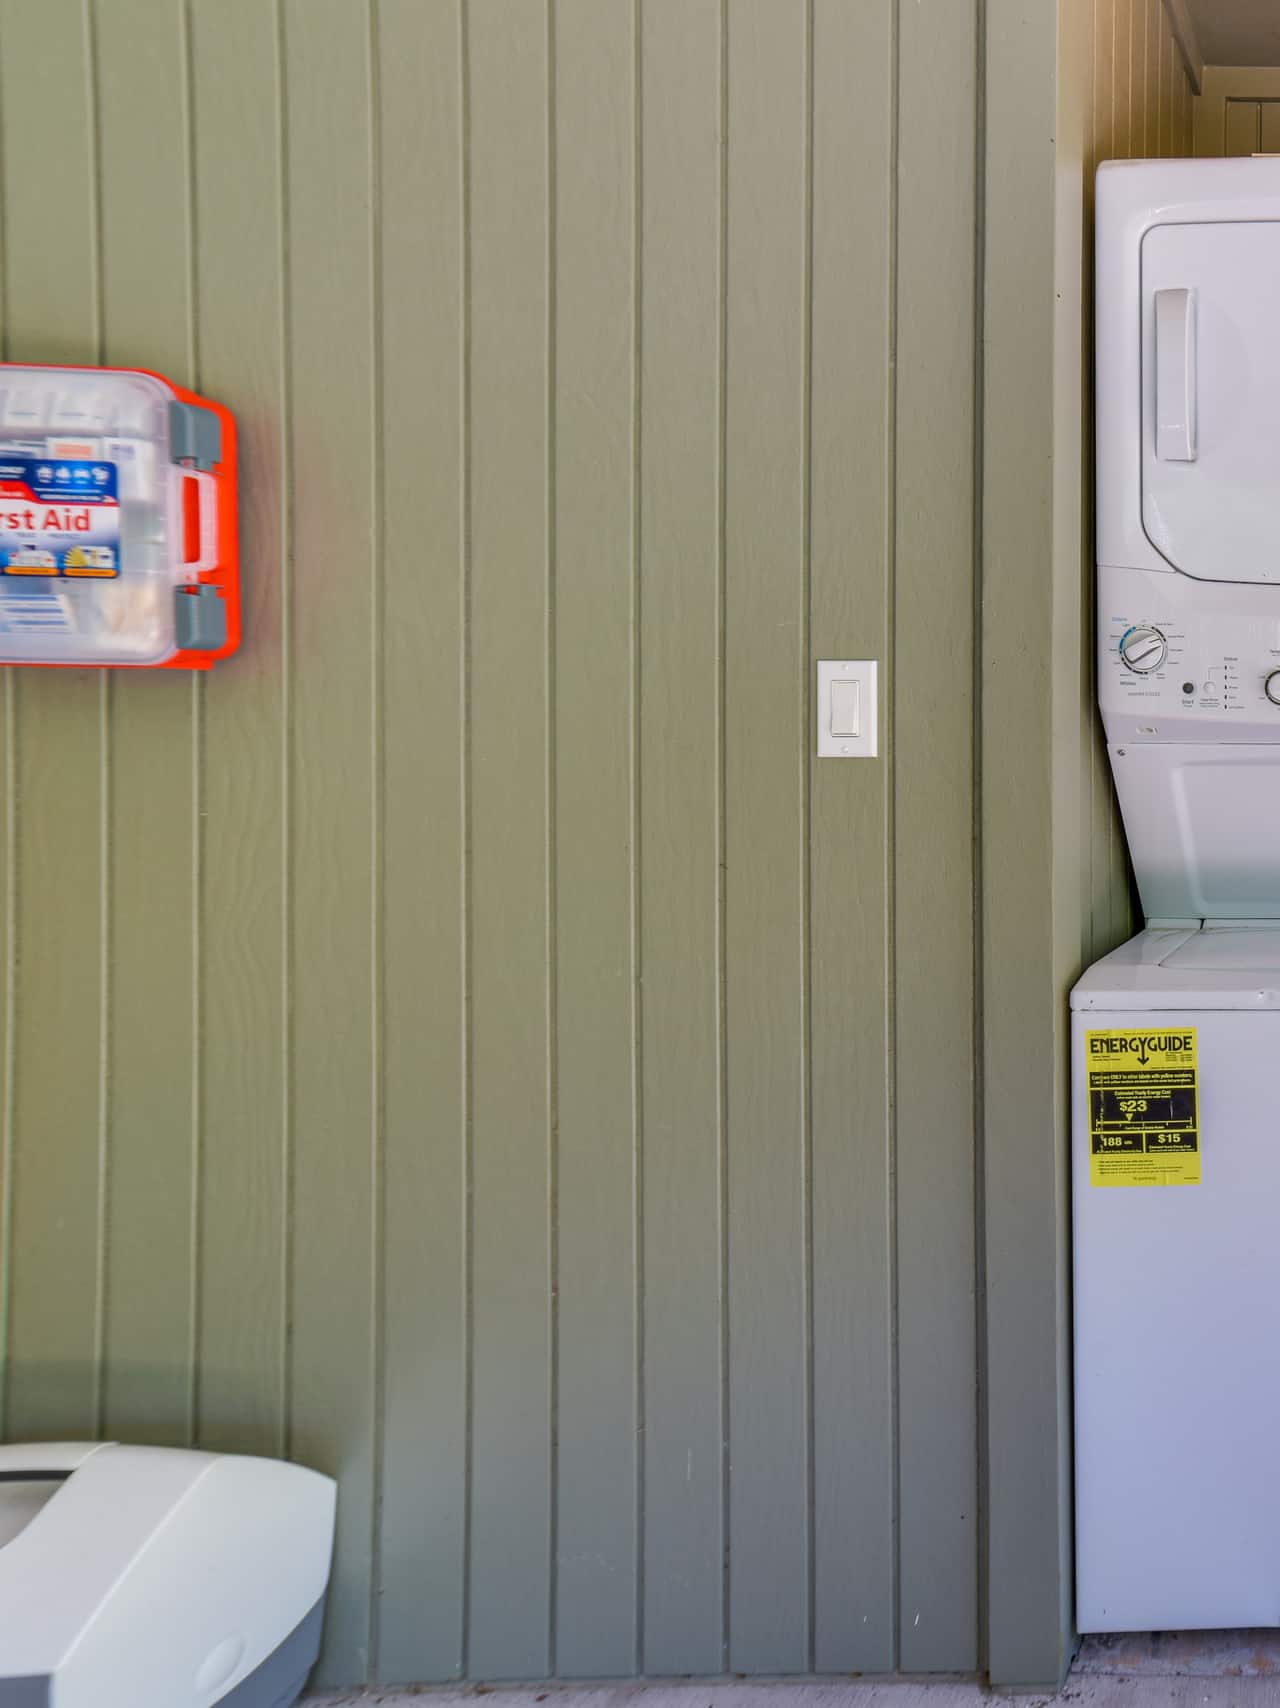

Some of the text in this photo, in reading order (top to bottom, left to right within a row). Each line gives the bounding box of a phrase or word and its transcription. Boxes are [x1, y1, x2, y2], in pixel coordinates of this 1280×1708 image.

[43, 508, 90, 531] Aid
[1090, 1035, 1193, 1055] ENERGYGUIDE
[1119, 1100, 1148, 1112] $23
[1158, 1133, 1181, 1143] $15
